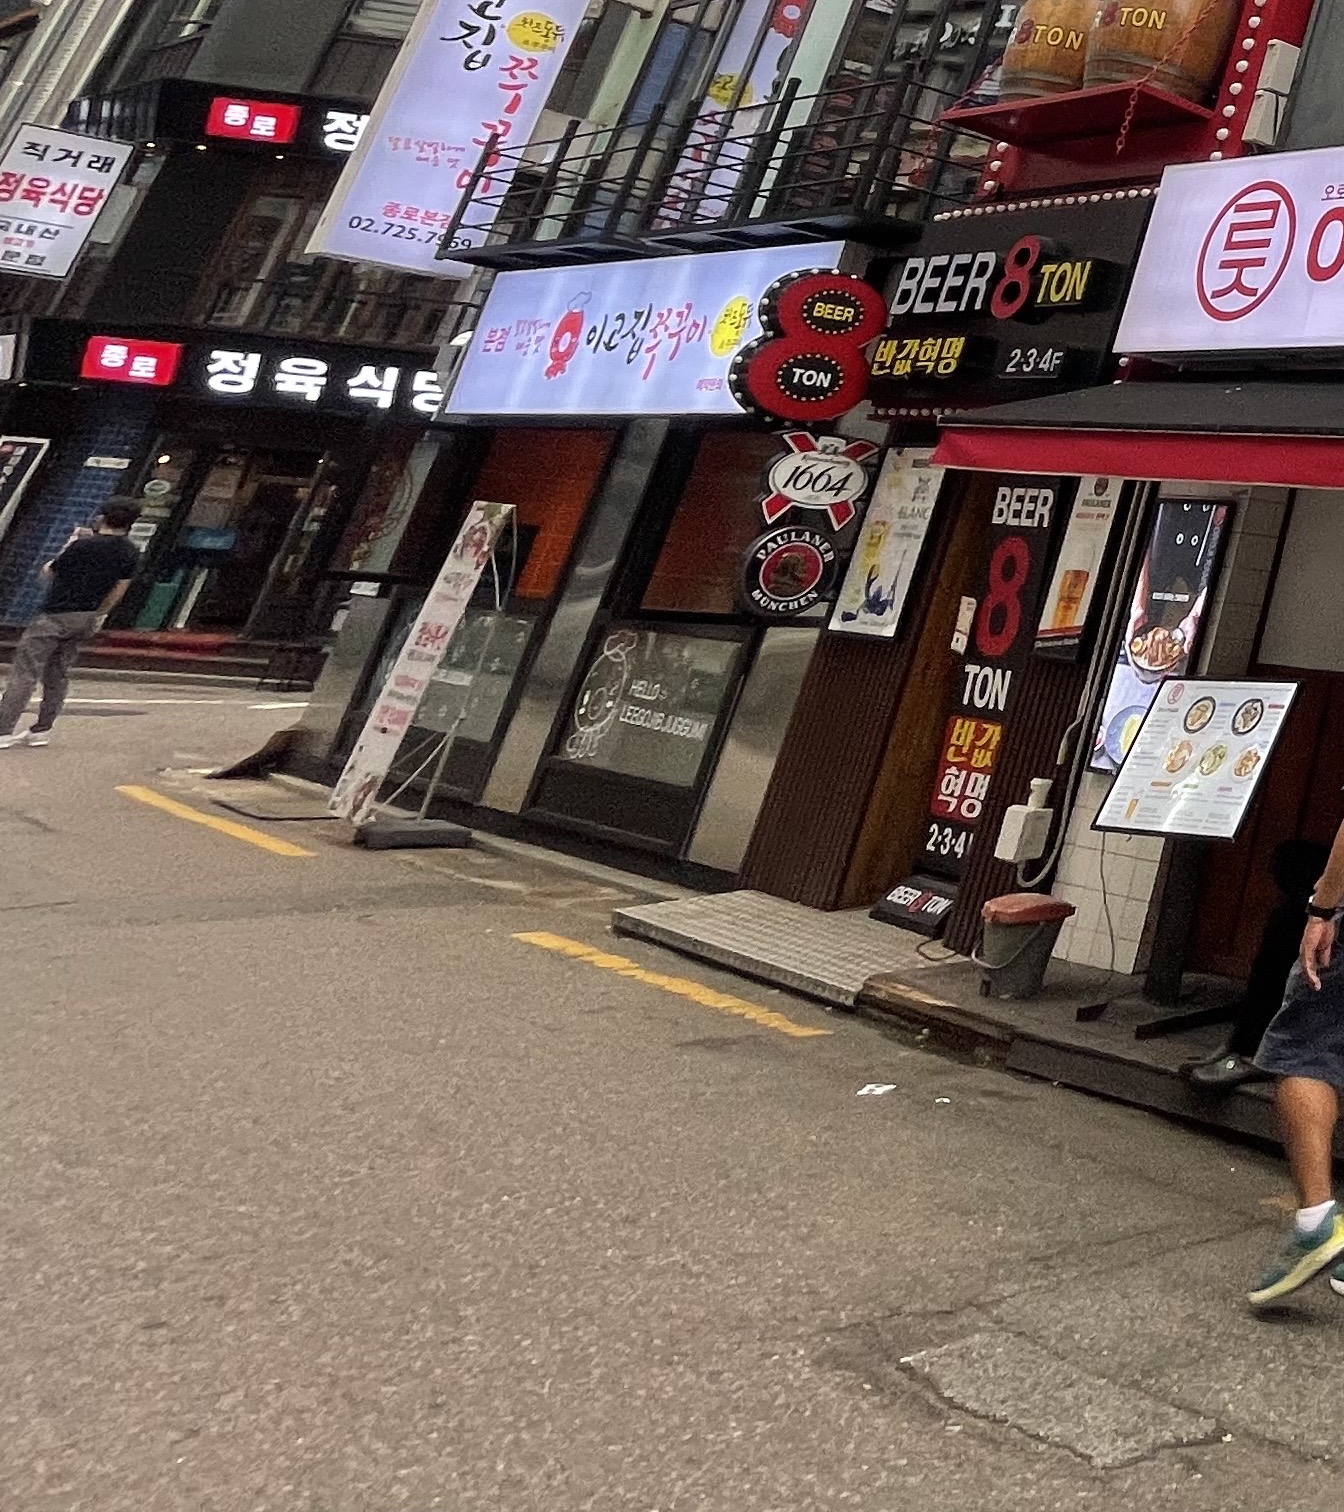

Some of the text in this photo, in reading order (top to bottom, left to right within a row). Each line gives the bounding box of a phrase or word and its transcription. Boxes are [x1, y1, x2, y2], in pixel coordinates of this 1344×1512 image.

[1119, 7, 1168, 30] TON
[1033, 25, 1084, 51] TON
[223, 103, 278, 137] 종로
[22, 141, 116, 173] 직거래
[0, 172, 105, 216] 정육식당
[890, 234, 1092, 319] BEER 8 TON
[813, 302, 856, 324] BEER
[100, 344, 157, 380] 종로
[791, 368, 832, 390] TON
[782, 463, 854, 497] 1664
[991, 486, 1055, 529] BEER
[756, 531, 836, 564] PAULANER
[976, 535, 1031, 657] 8
[962, 663, 1013, 711] TON
